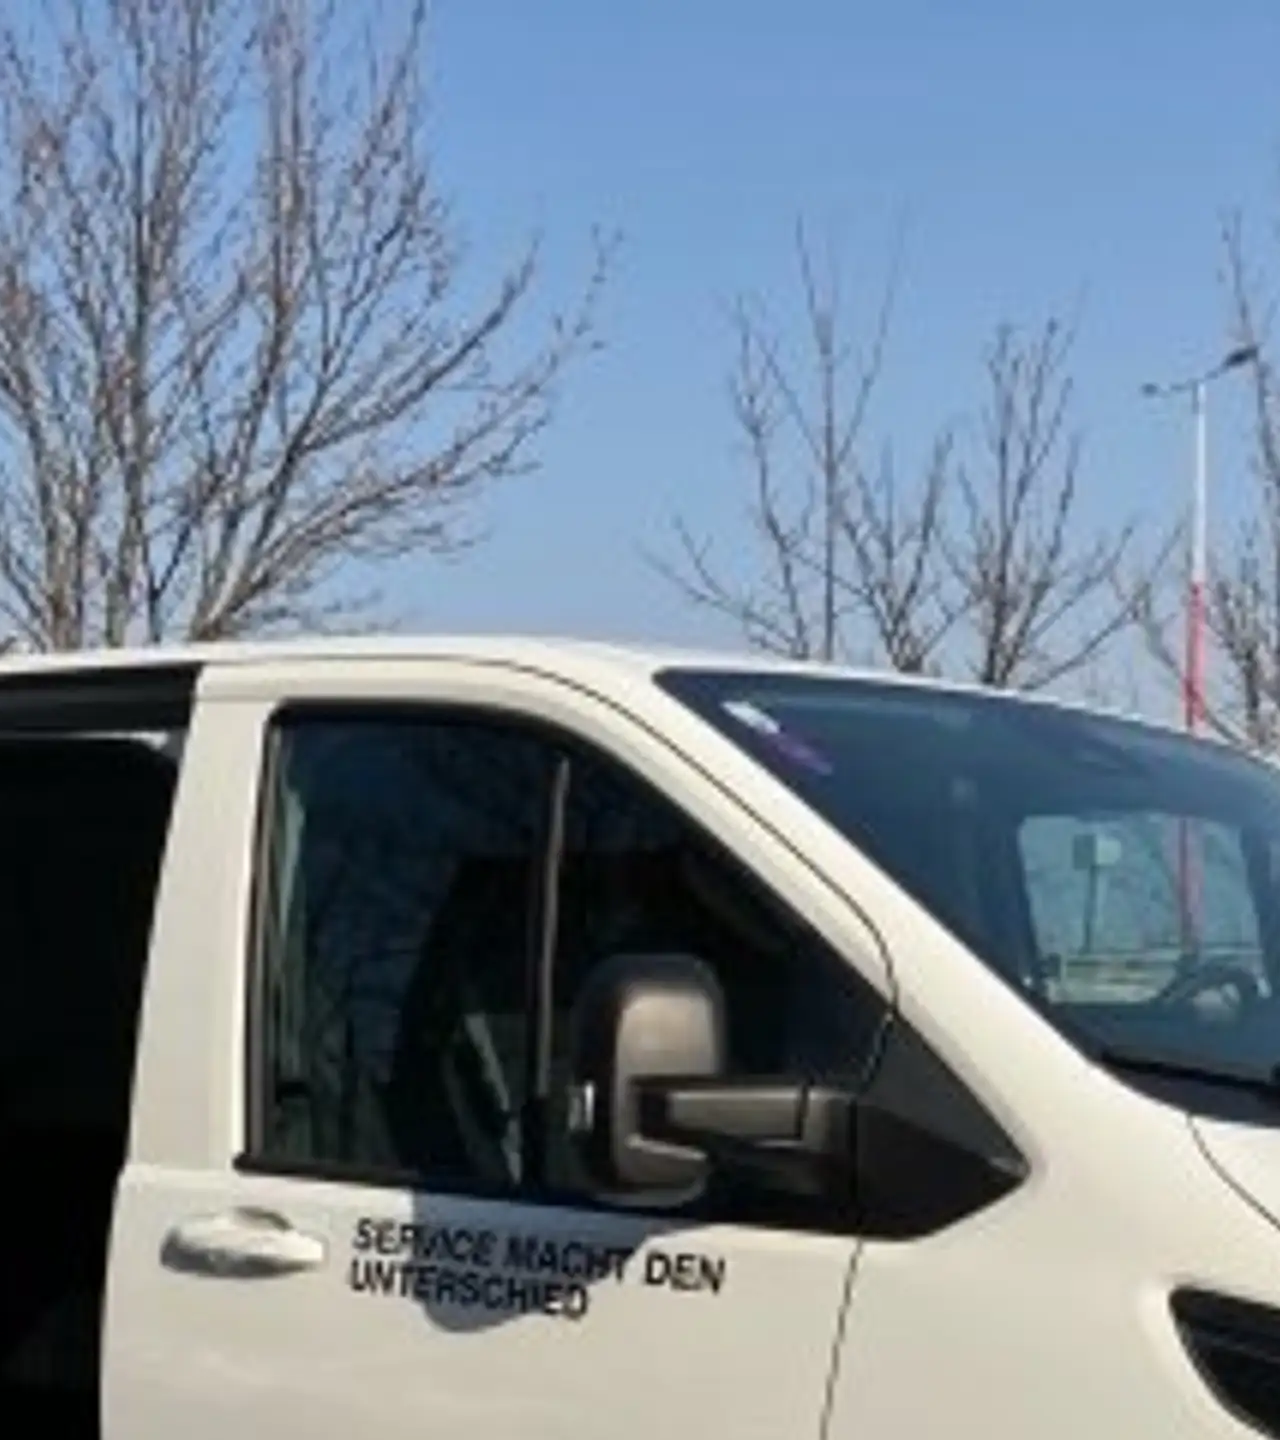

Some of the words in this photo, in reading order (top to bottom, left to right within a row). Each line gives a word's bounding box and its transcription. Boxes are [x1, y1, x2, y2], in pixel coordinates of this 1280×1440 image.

[349, 1257, 589, 1322] UNTERSCHIED
[352, 1217, 498, 1267] SERVICE
[502, 1236, 636, 1284] MACHT
[644, 1249, 726, 1294] DEN
